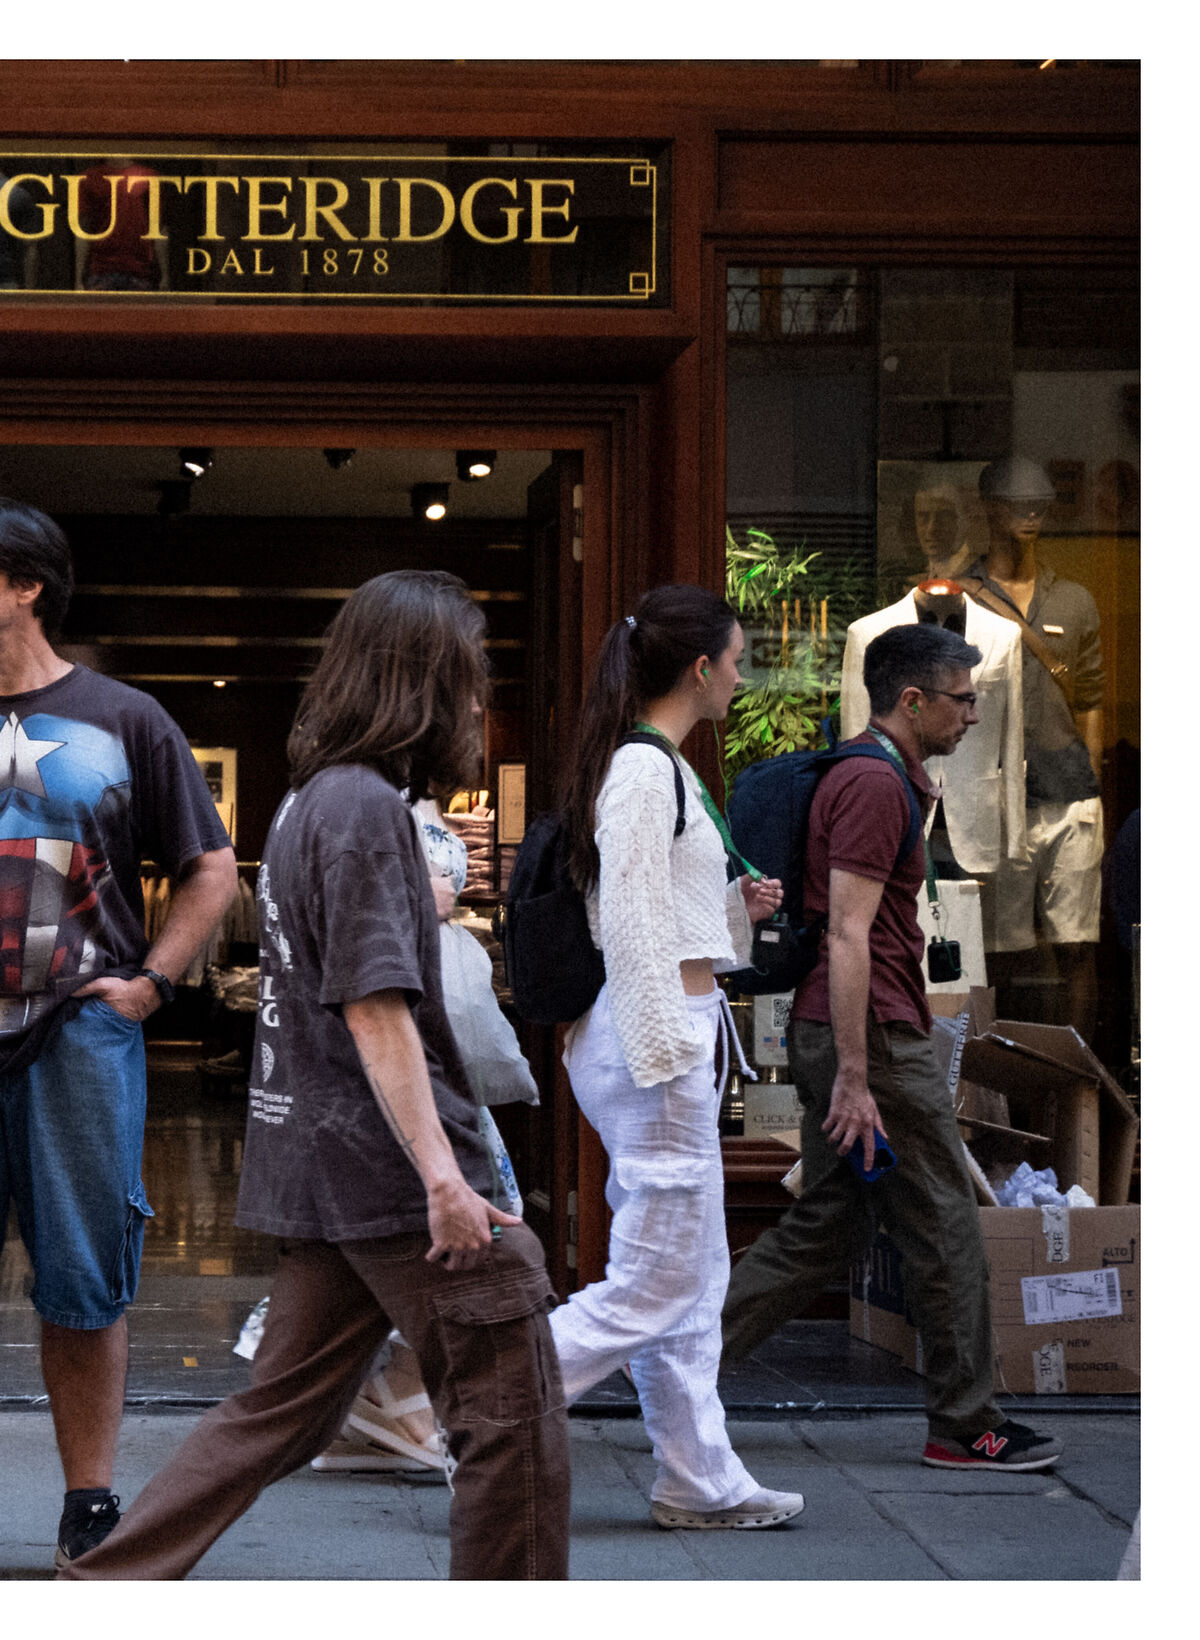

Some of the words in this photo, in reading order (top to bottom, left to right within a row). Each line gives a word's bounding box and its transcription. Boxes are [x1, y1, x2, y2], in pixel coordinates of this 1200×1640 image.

[186, 248, 275, 275] DAL
[299, 248, 391, 276] 1878
[753, 1114, 785, 1124] CLICK
[1103, 1247, 1128, 1257] ALTO
[1066, 1338, 1091, 1348] NEW
